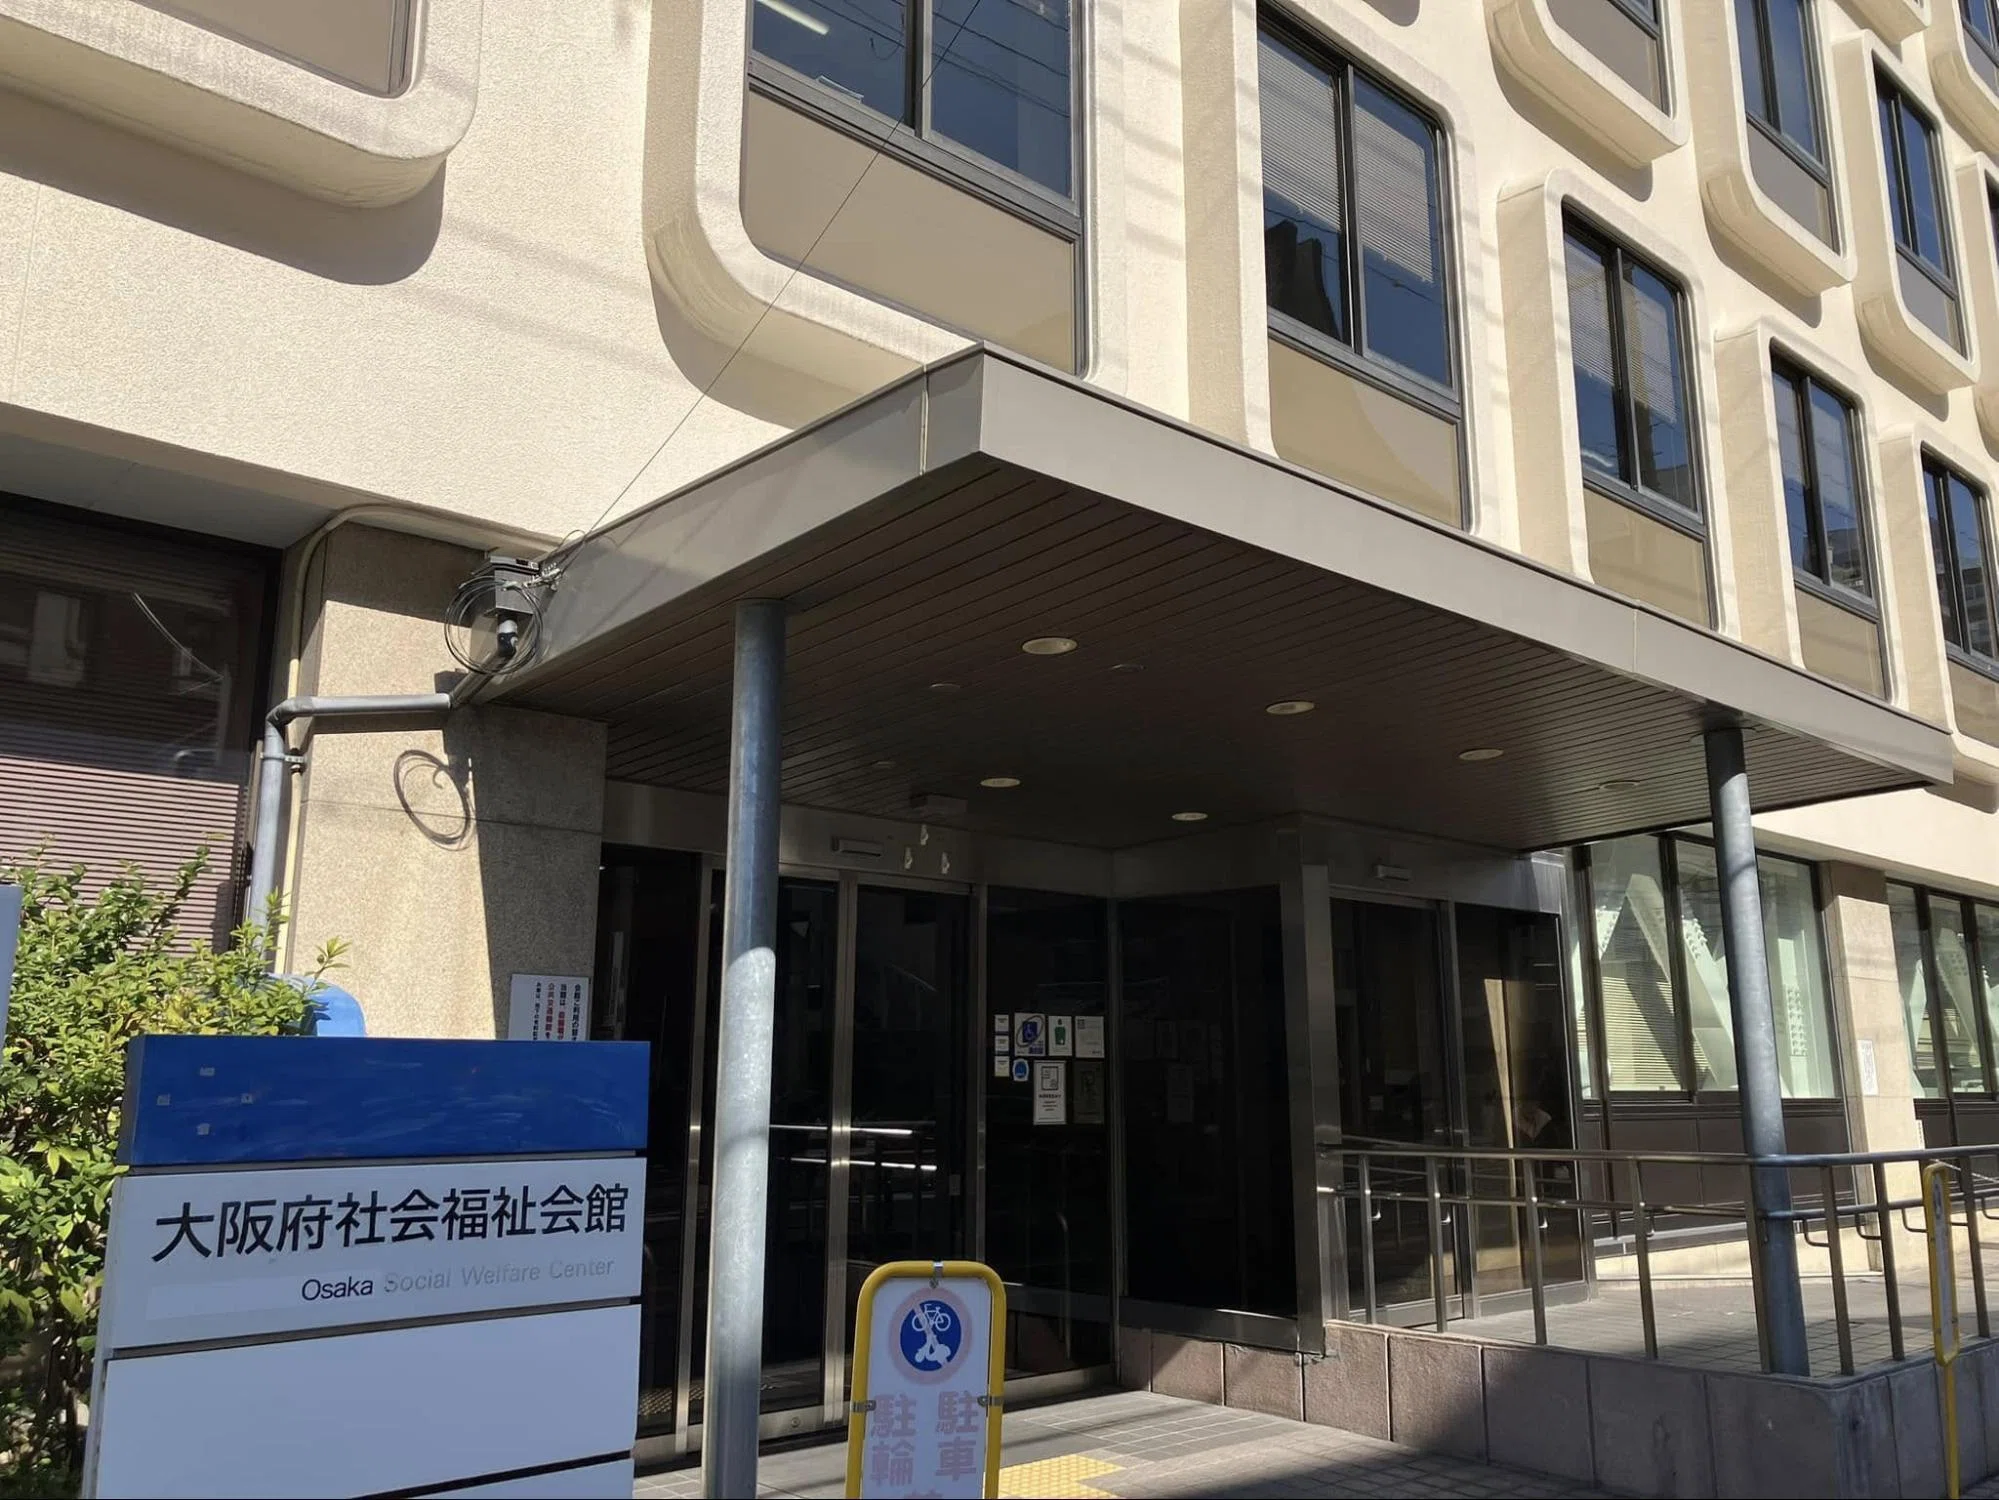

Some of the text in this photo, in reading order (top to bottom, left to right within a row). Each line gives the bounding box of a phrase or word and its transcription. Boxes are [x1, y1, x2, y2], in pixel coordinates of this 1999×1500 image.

[152, 1183, 629, 1262] 大阪府社会福祉会館
[301, 1257, 615, 1301] Osaka Social Welfare Center
[870, 1393, 916, 1487] 駐輪
[935, 1389, 979, 1482] 駐車
